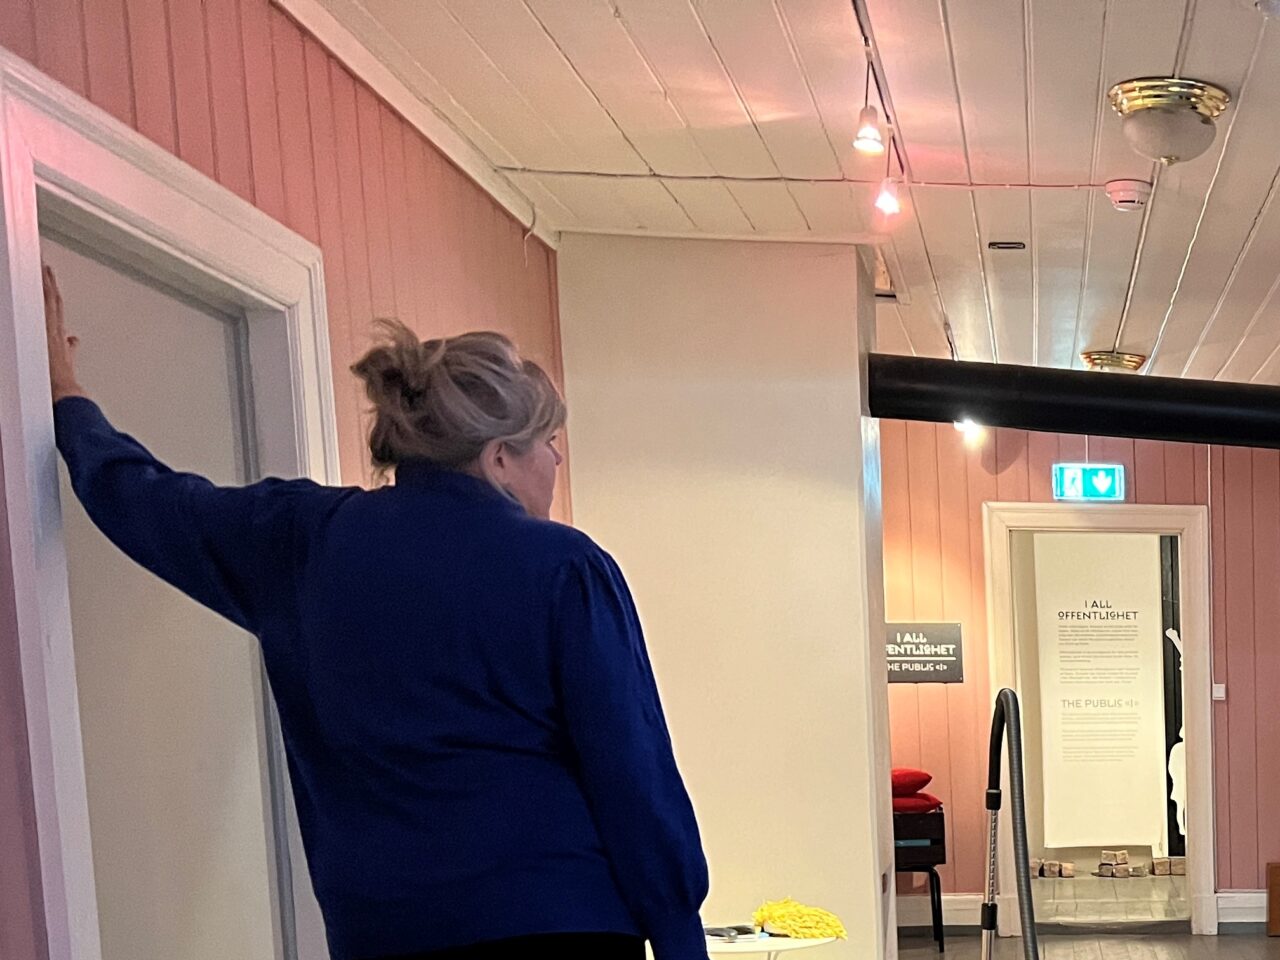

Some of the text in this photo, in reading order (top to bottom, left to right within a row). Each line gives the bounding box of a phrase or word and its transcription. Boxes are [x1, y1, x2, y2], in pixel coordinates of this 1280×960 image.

[1091, 600, 1112, 608] ALL
[896, 632, 927, 643] I ALL
[886, 644, 956, 655] ENTLIGHET
[887, 663, 901, 671] HE
[1061, 699, 1082, 709] THE
